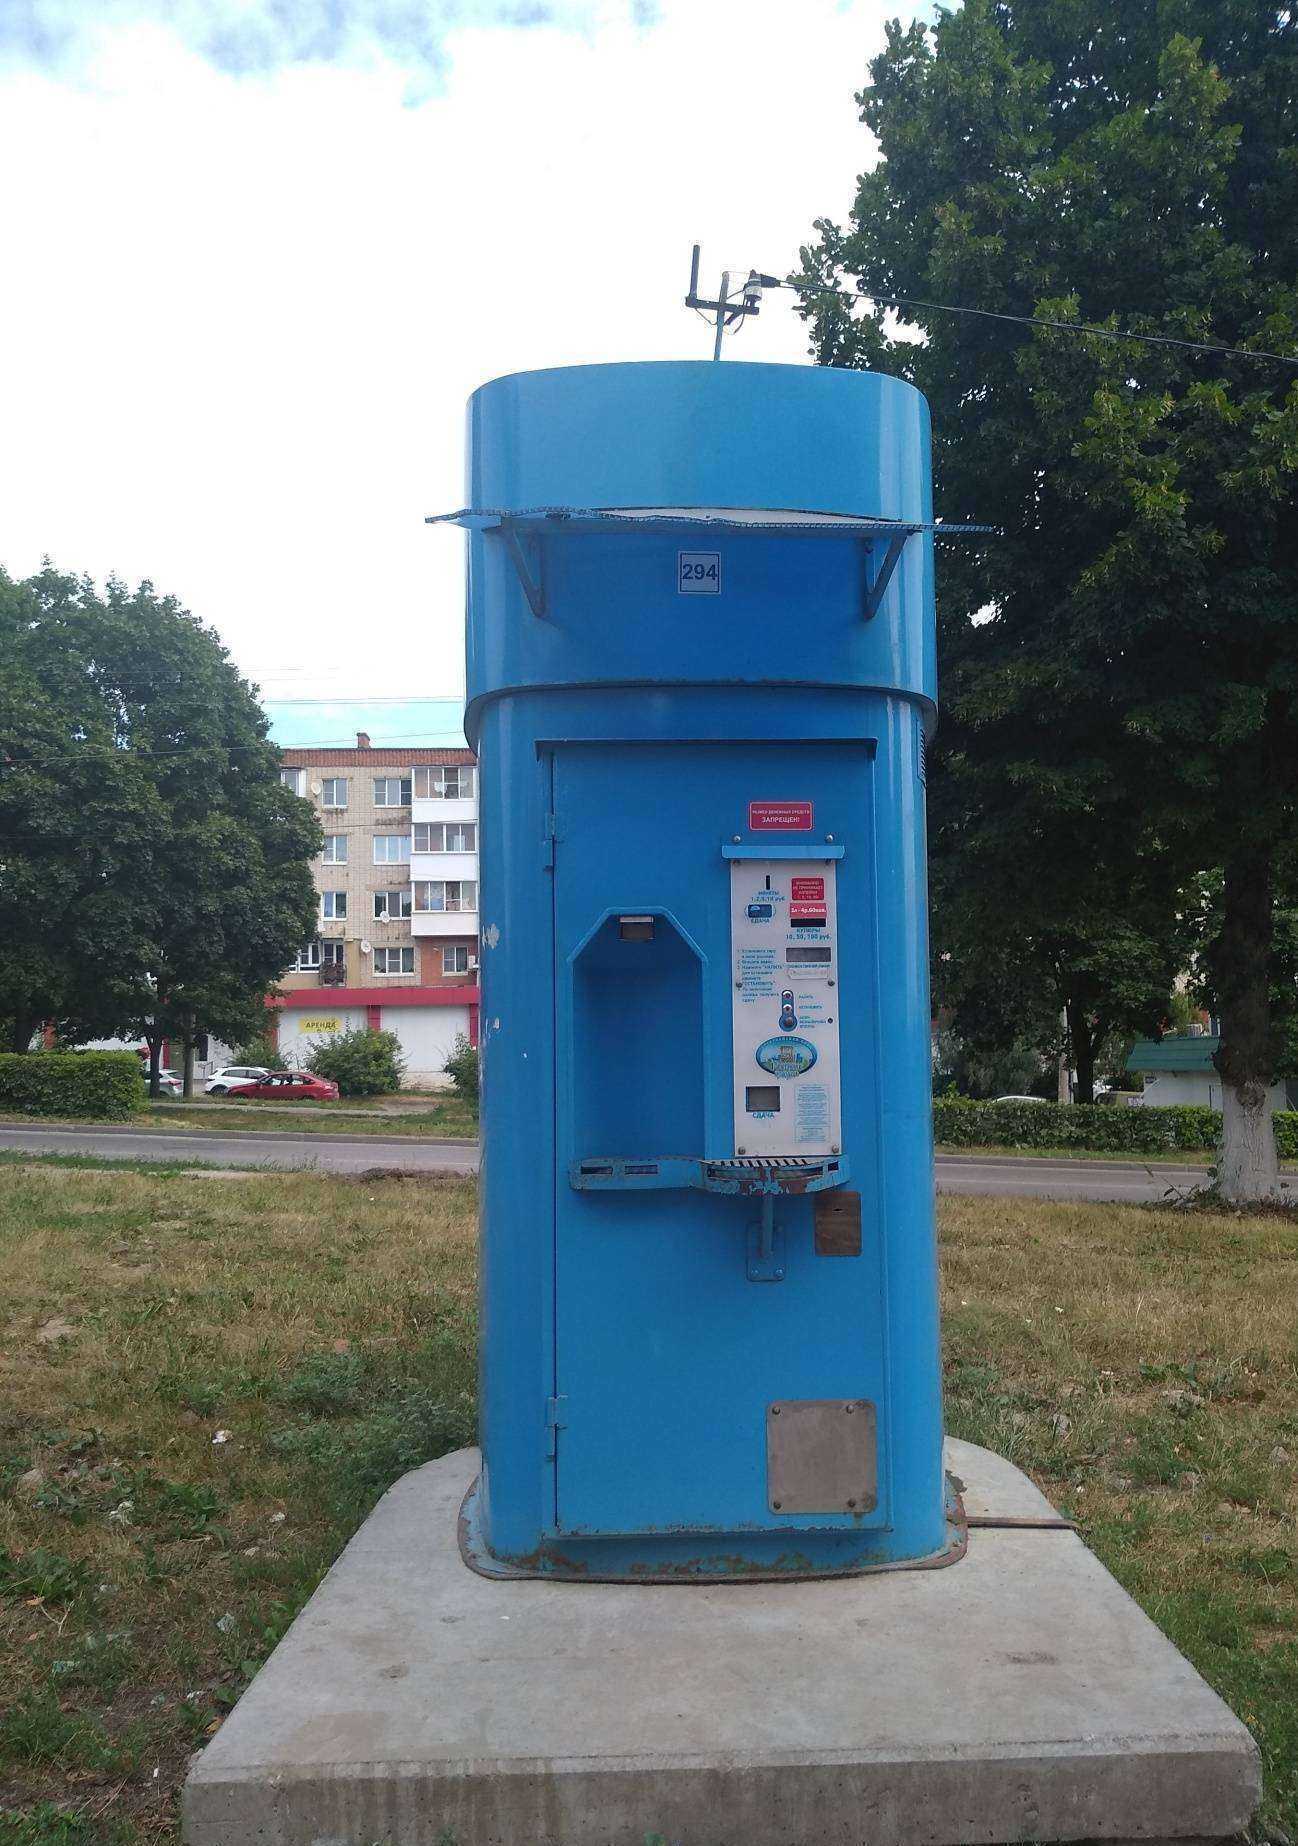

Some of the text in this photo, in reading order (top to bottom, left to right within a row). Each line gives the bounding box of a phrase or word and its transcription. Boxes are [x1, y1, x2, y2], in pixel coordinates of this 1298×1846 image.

[683, 564, 718, 580] 294
[761, 816, 800, 824] ЗАПРЕЩЕН!
[305, 1021, 336, 1029] АРЕНДА
